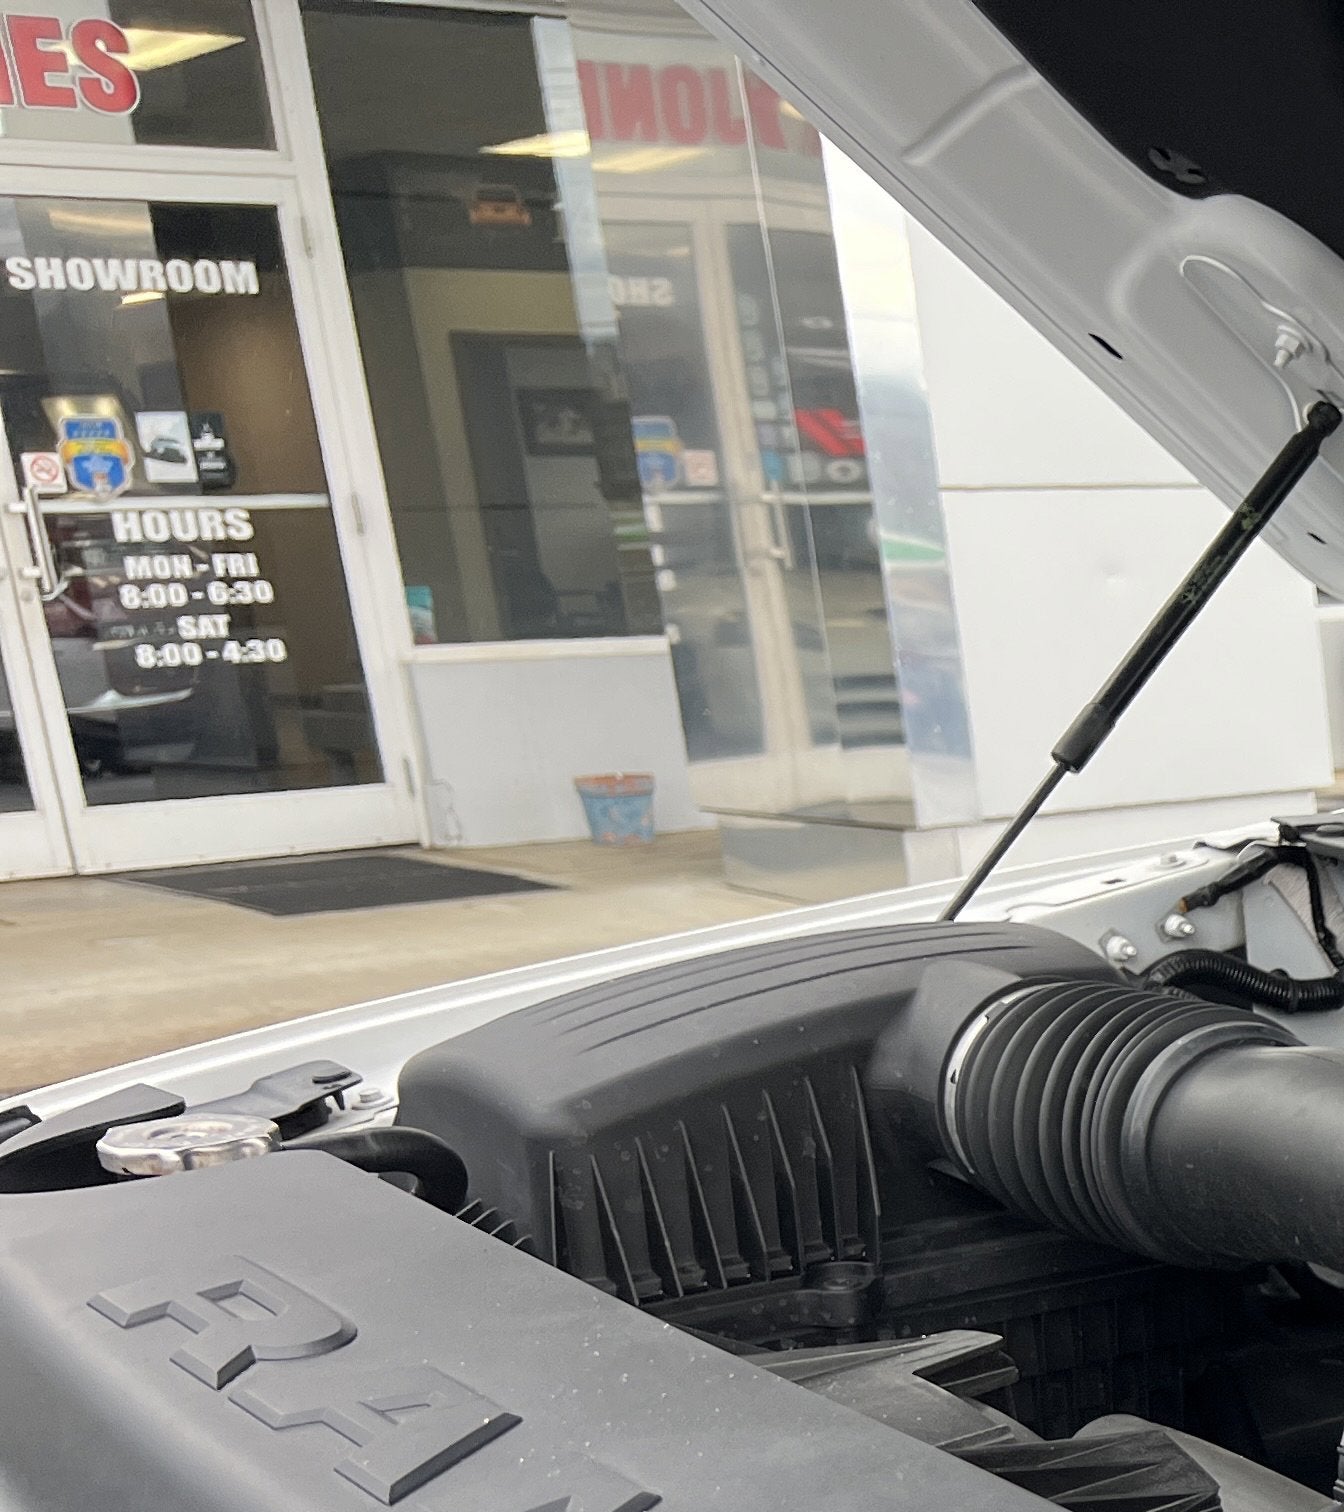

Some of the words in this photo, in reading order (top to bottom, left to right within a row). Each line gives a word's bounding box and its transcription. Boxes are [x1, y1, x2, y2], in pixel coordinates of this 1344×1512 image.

[0, 14, 140, 116] ES
[5, 256, 259, 295] SHOWROOM
[110, 507, 254, 543] HOURS
[177, 613, 231, 640] SAT
